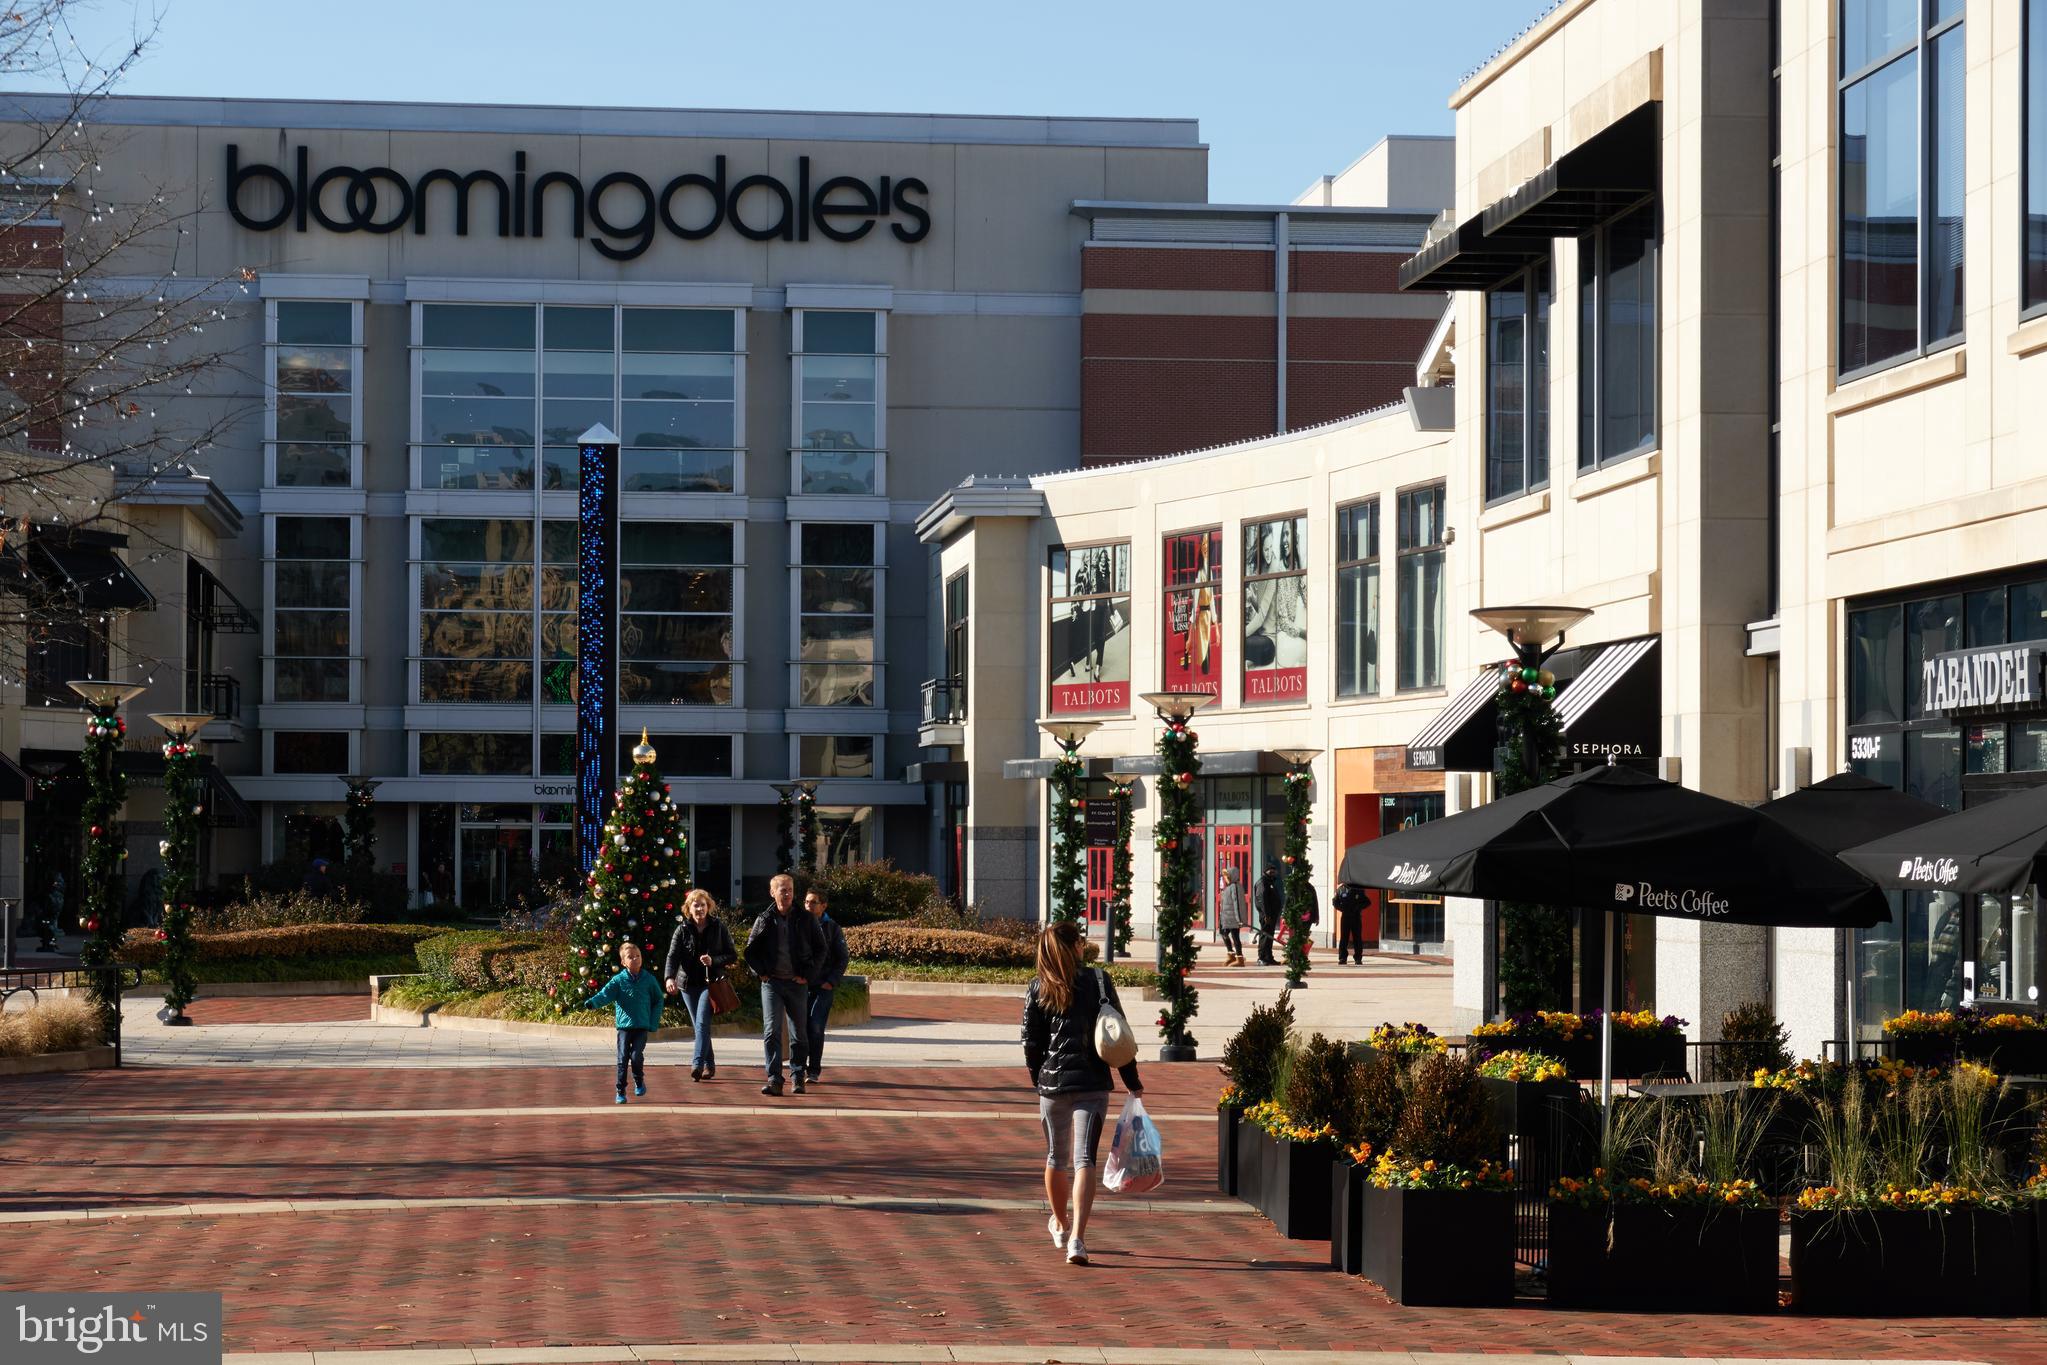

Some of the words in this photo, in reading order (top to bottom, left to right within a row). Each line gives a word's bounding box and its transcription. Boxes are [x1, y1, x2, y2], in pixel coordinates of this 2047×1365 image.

[226, 143, 932, 262] bloomingdale's
[1251, 674, 1302, 694] TALBOTS
[1923, 648, 2031, 712] TABANDEH
[1062, 688, 1121, 706] TALBOTS
[1413, 750, 1436, 766] SEPHORA
[1573, 743, 1642, 755] SEPHORA
[1852, 736, 1881, 759] 5330-F
[1910, 856, 1934, 882] Peet's
[1933, 858, 1959, 885] Coffee
[1639, 881, 1678, 910] Peet's
[1681, 889, 1729, 916] Coffee
